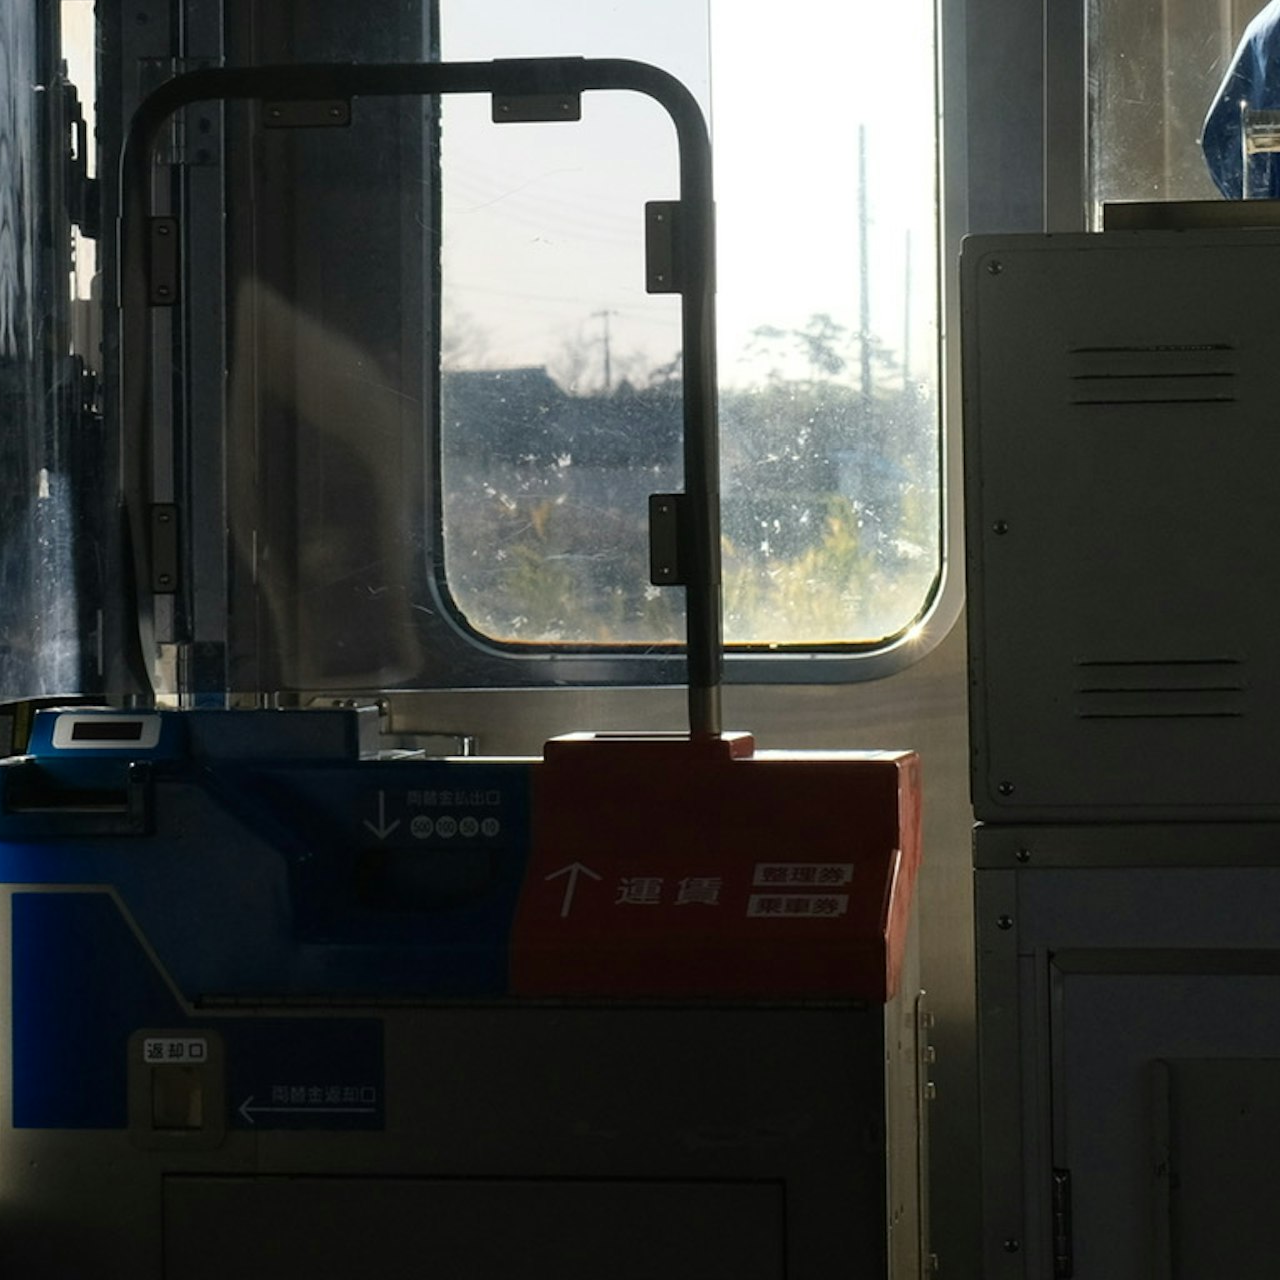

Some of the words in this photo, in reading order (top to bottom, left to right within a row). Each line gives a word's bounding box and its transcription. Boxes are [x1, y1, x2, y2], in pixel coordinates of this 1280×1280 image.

[762, 866, 845, 882] 整理券
[614, 876, 721, 906] 運賃
[756, 897, 840, 914] 乗車券
[148, 1043, 203, 1059] 返却口
[271, 1085, 376, 1103] 両替金返却口
